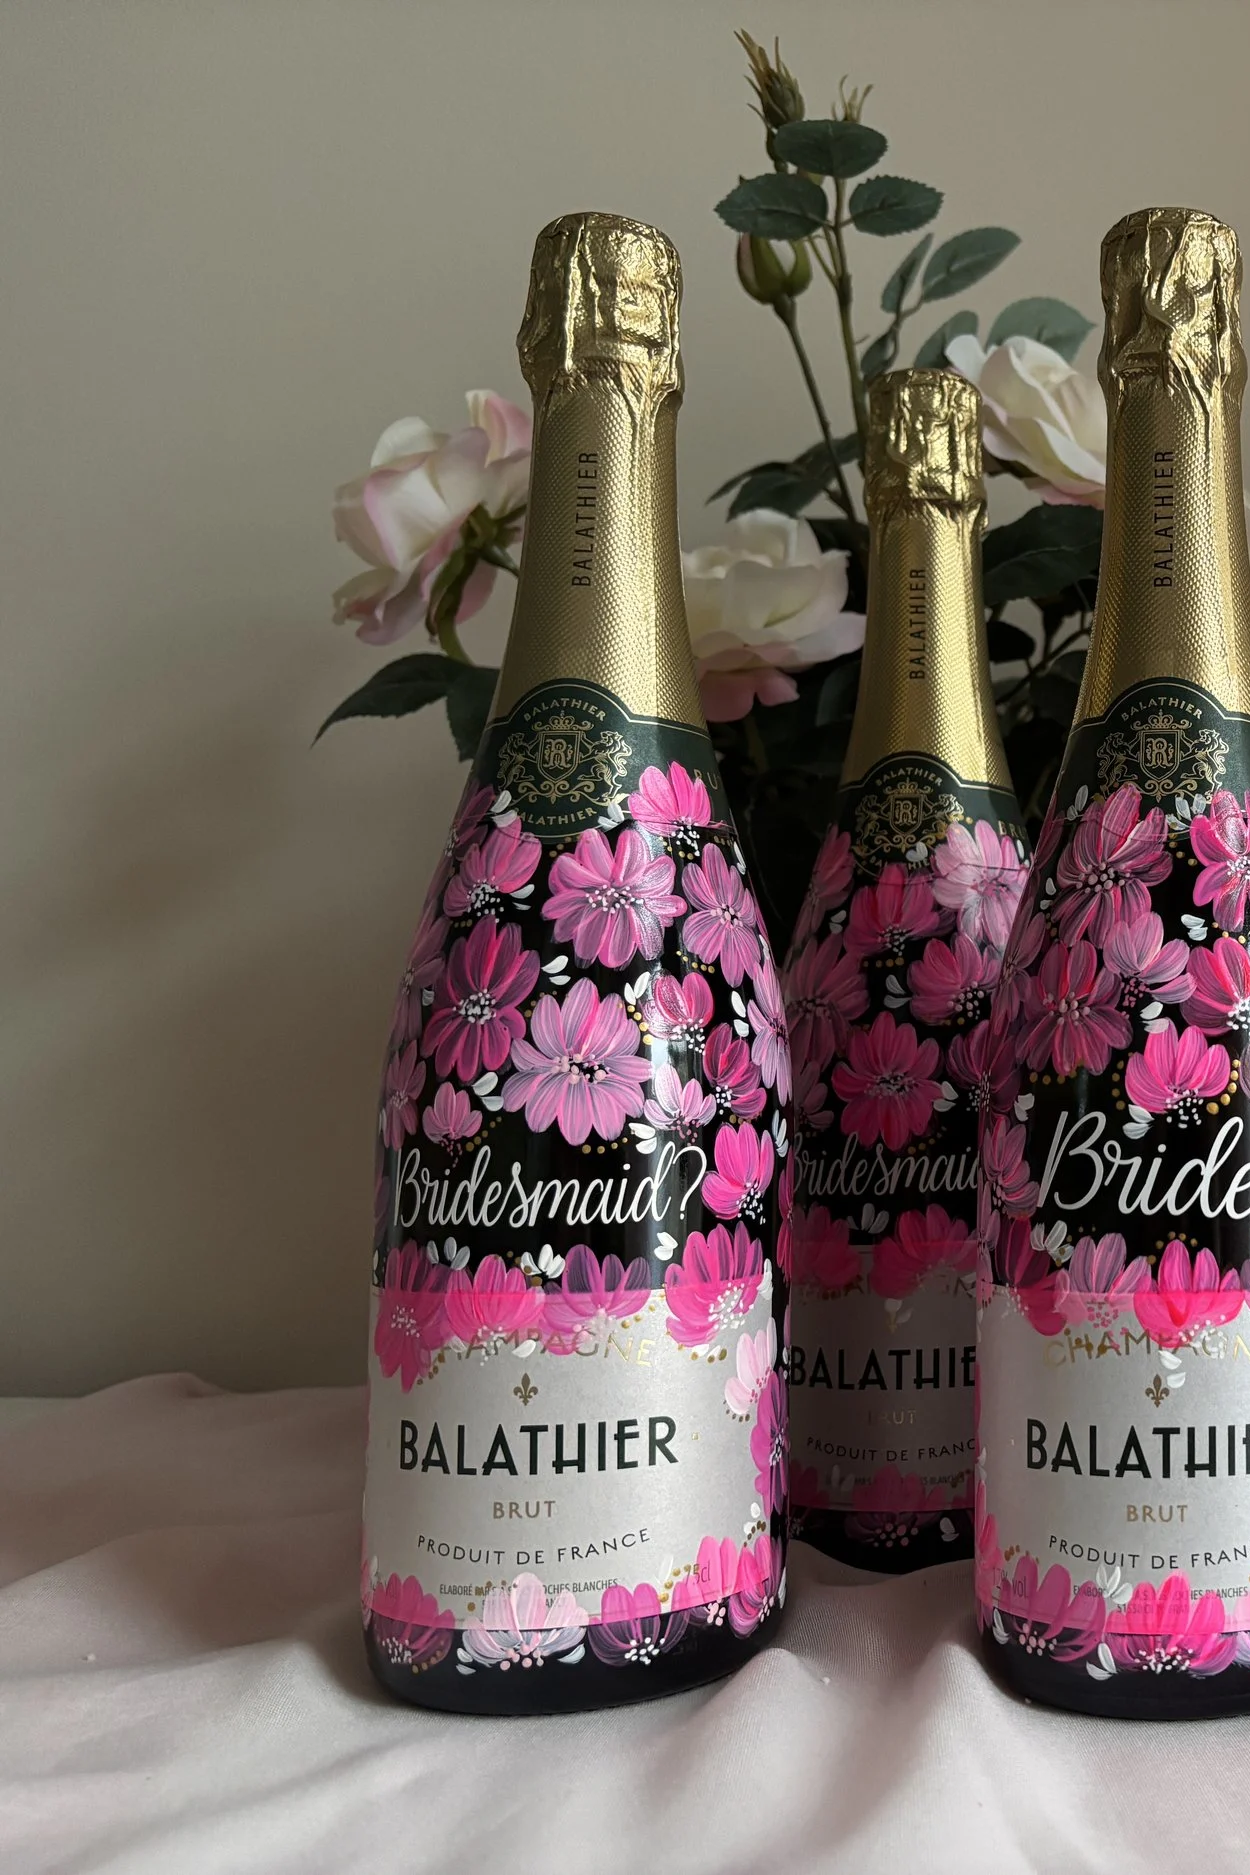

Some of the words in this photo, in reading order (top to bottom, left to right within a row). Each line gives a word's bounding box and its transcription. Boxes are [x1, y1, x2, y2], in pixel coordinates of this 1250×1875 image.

[572, 451, 598, 586] BALATHIER
[1154, 451, 1173, 587] BALATHIER
[909, 569, 926, 679] BALATHIER
[524, 697, 607, 722] BALATHIER
[1120, 696, 1203, 722] BALATHIER
[875, 766, 943, 787] BALATHIER
[395, 1141, 708, 1228] Bridesmaid?
[790, 1346, 976, 1391] BALATHIE
[399, 1416, 679, 1476] BALATHIER
[807, 1436, 877, 1462] PRODUIT
[886, 1450, 908, 1462] DE
[918, 1438, 975, 1460] FRANC
[492, 1500, 556, 1519] BRUT
[1126, 1505, 1188, 1523] BRUT
[417, 1534, 505, 1566] PRODUIT
[516, 1551, 545, 1565] DE
[557, 1528, 650, 1563] FRANCE
[1049, 1535, 1140, 1569] PRODUIT
[1152, 1553, 1179, 1569] DE
